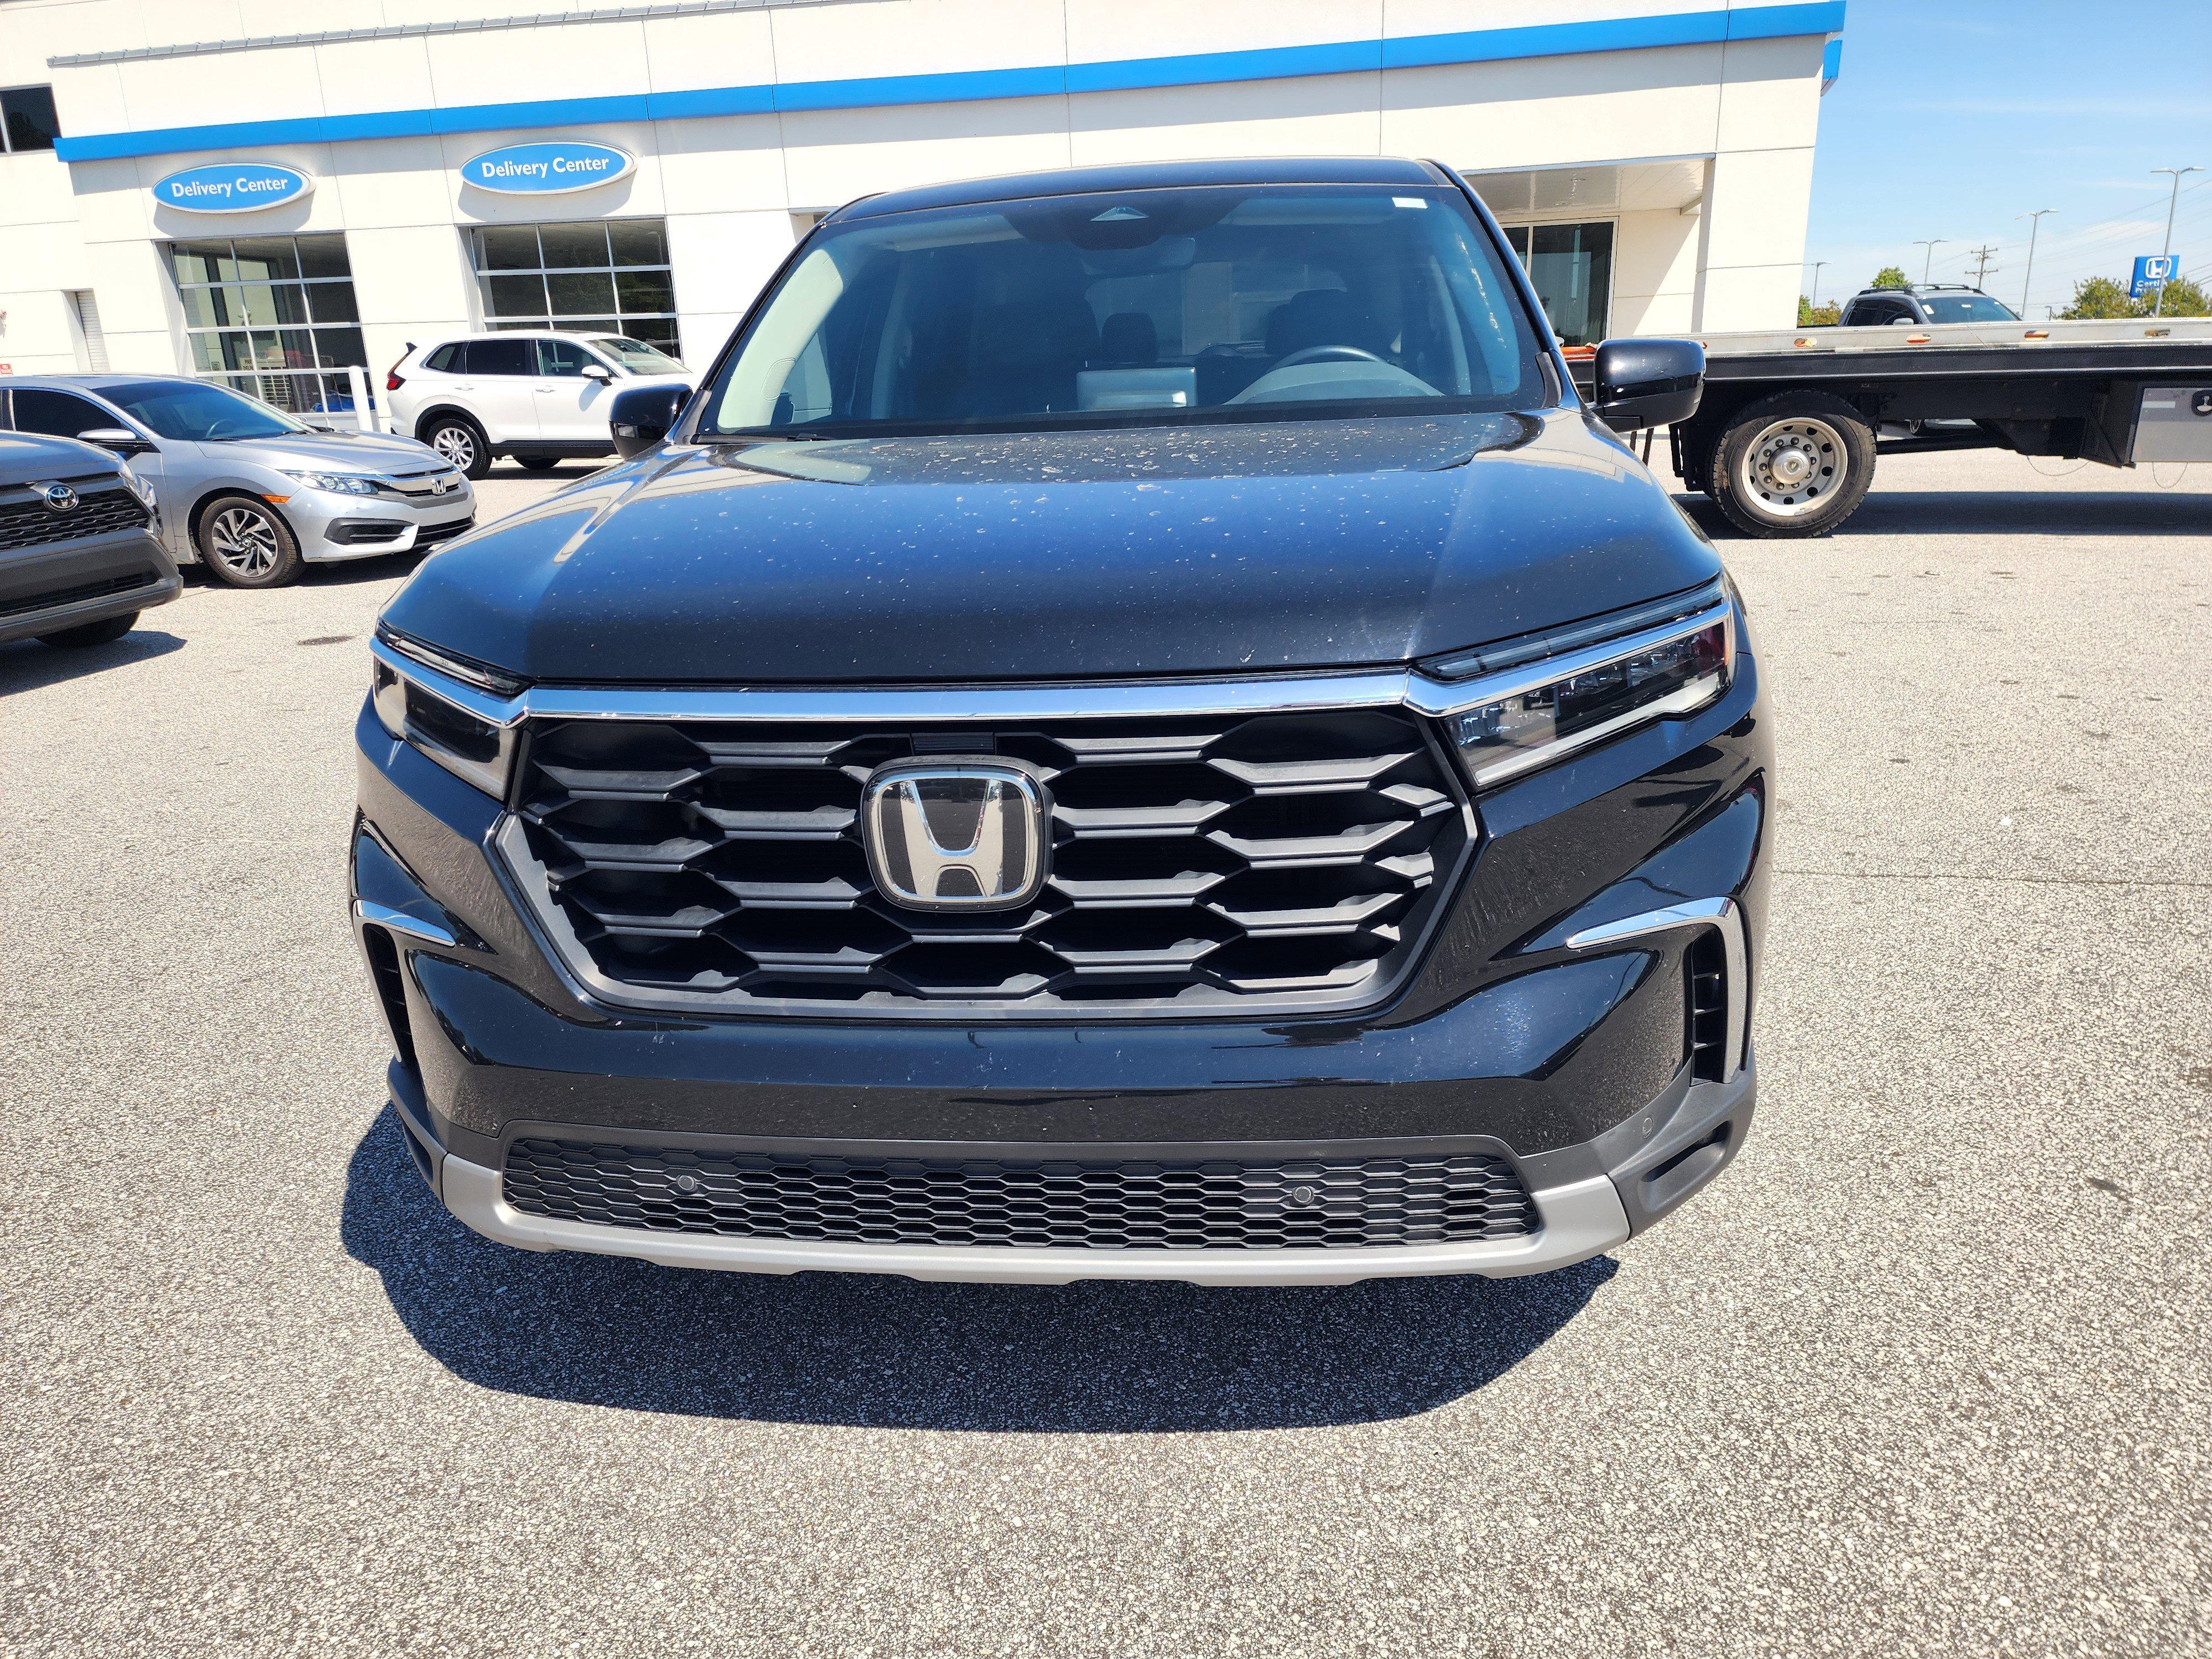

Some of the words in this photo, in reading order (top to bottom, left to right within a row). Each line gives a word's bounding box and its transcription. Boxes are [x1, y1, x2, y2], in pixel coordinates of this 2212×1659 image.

[480, 161, 548, 179] Delivery
[552, 157, 609, 173] Center
[171, 181, 232, 197] Delivery
[236, 178, 288, 192] Center
